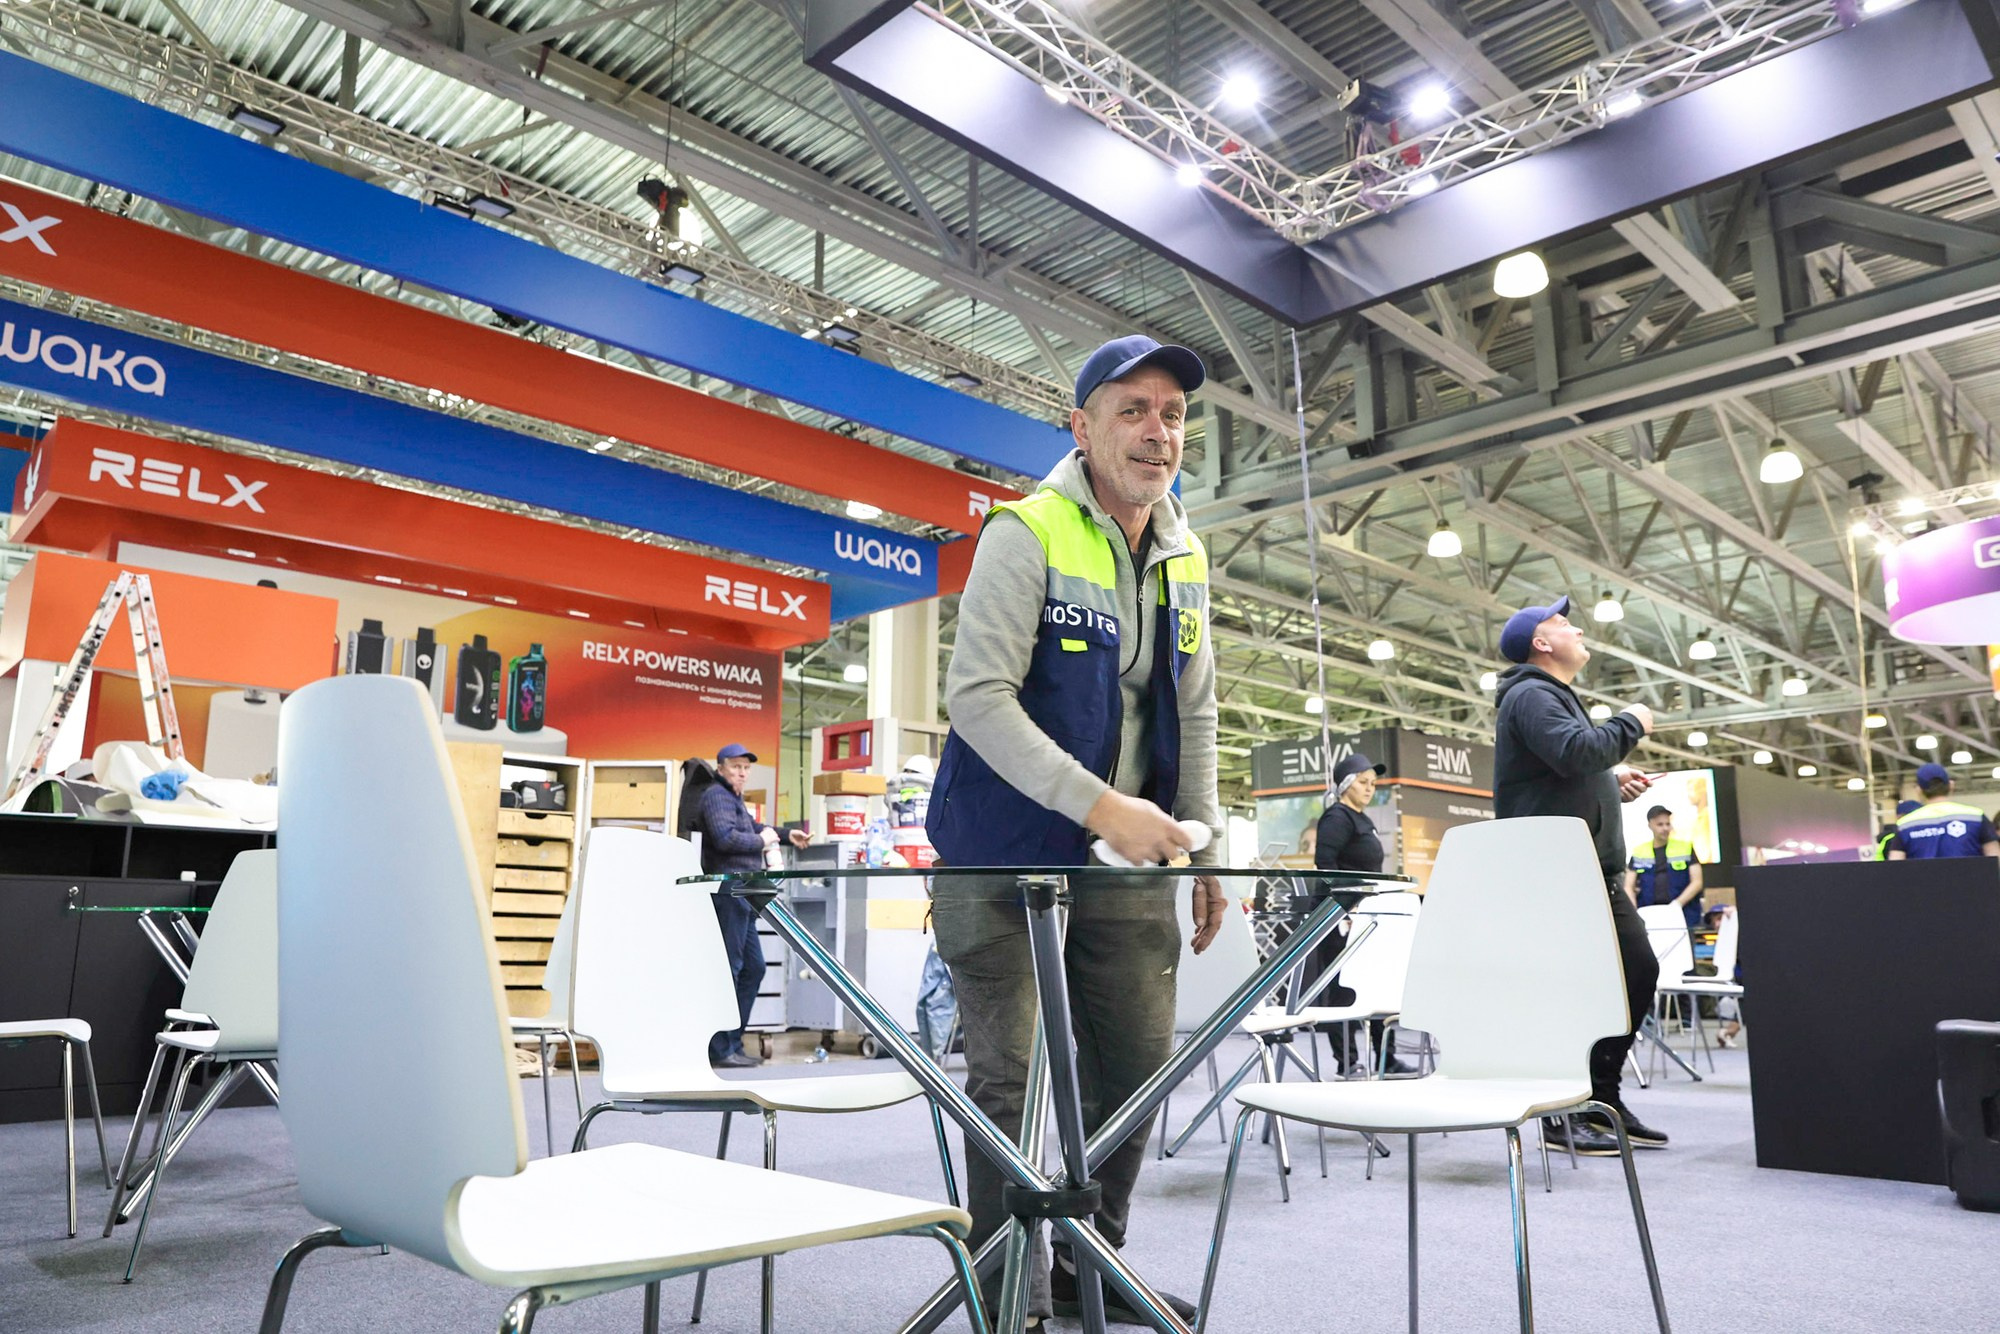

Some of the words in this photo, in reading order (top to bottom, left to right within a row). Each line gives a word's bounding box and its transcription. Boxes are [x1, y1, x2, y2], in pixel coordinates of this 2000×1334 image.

[89, 447, 269, 514] RELX
[704, 574, 808, 621] RELX
[582, 640, 629, 665] RELX
[633, 649, 710, 677] POWERS
[713, 661, 763, 686] WAKA
[1426, 743, 1472, 776] ENVA
